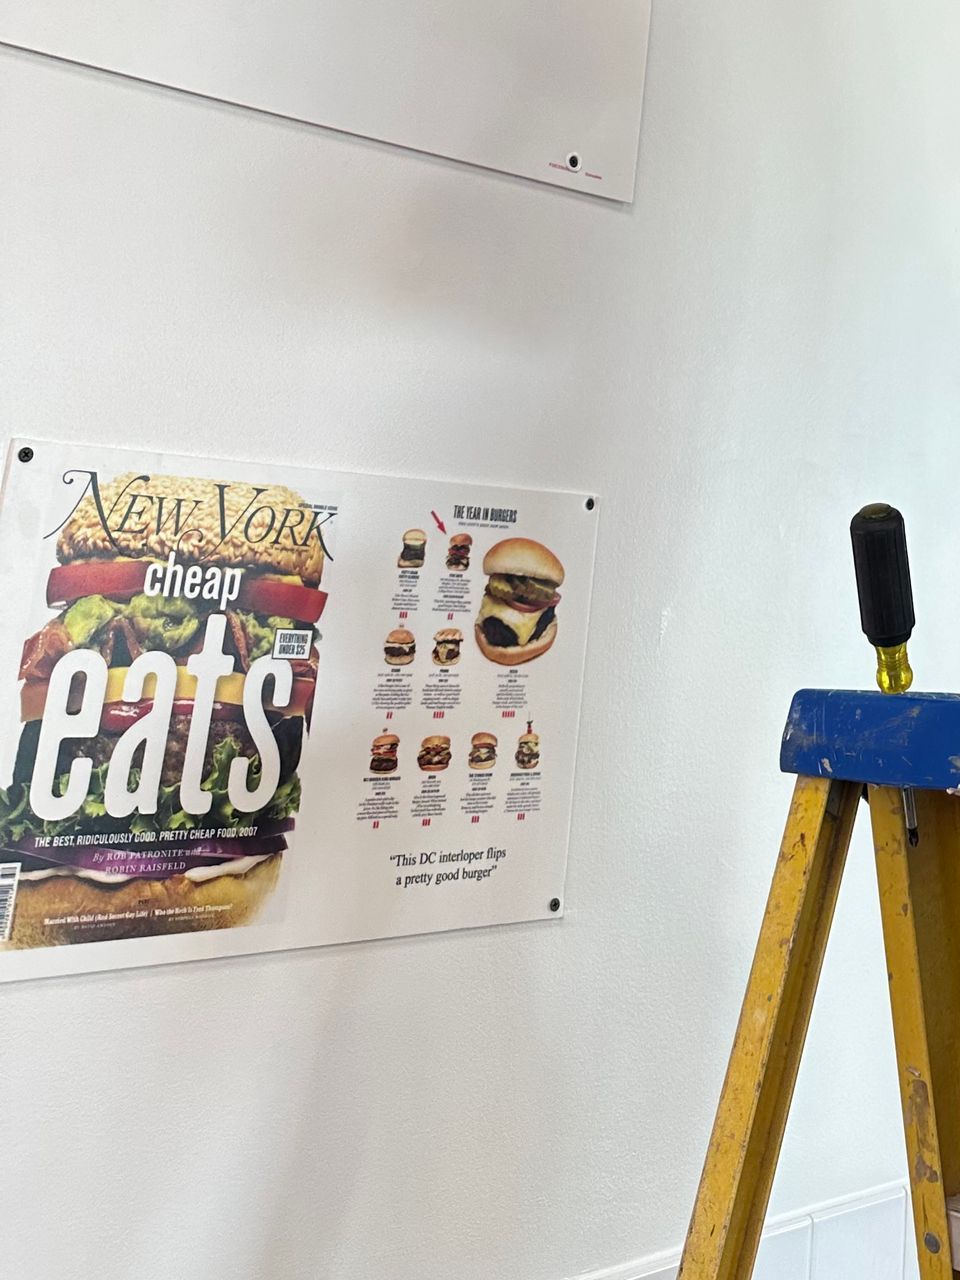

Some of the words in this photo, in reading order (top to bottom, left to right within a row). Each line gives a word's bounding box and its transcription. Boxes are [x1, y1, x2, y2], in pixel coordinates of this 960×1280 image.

[453, 505, 466, 520] THE
[466, 506, 481, 521] YEAR
[482, 507, 490, 522] IN
[490, 508, 518, 524] BURGERS
[143, 550, 242, 611] cheap
[279, 632, 309, 644] EVERYTHING
[278, 644, 295, 655] UNDER
[296, 644, 306, 655] $25
[29, 613, 295, 821] eats
[34, 837, 50, 848] THE
[76, 832, 133, 845] RIDICULOUSLY
[159, 830, 189, 841] PRETTY
[189, 828, 216, 839] CHEAP
[239, 826, 258, 837] 2007
[92, 853, 104, 863] By
[107, 852, 127, 861] ROB
[129, 849, 184, 859] PATRONITE
[419, 851, 437, 865] DC
[439, 849, 484, 864] interloper
[487, 847, 507, 861] flips
[105, 865, 137, 873] ROBIN
[139, 862, 186, 872] RAISFELD
[396, 876, 401, 885] a
[404, 872, 433, 888] pretty
[435, 868, 460, 885] good
